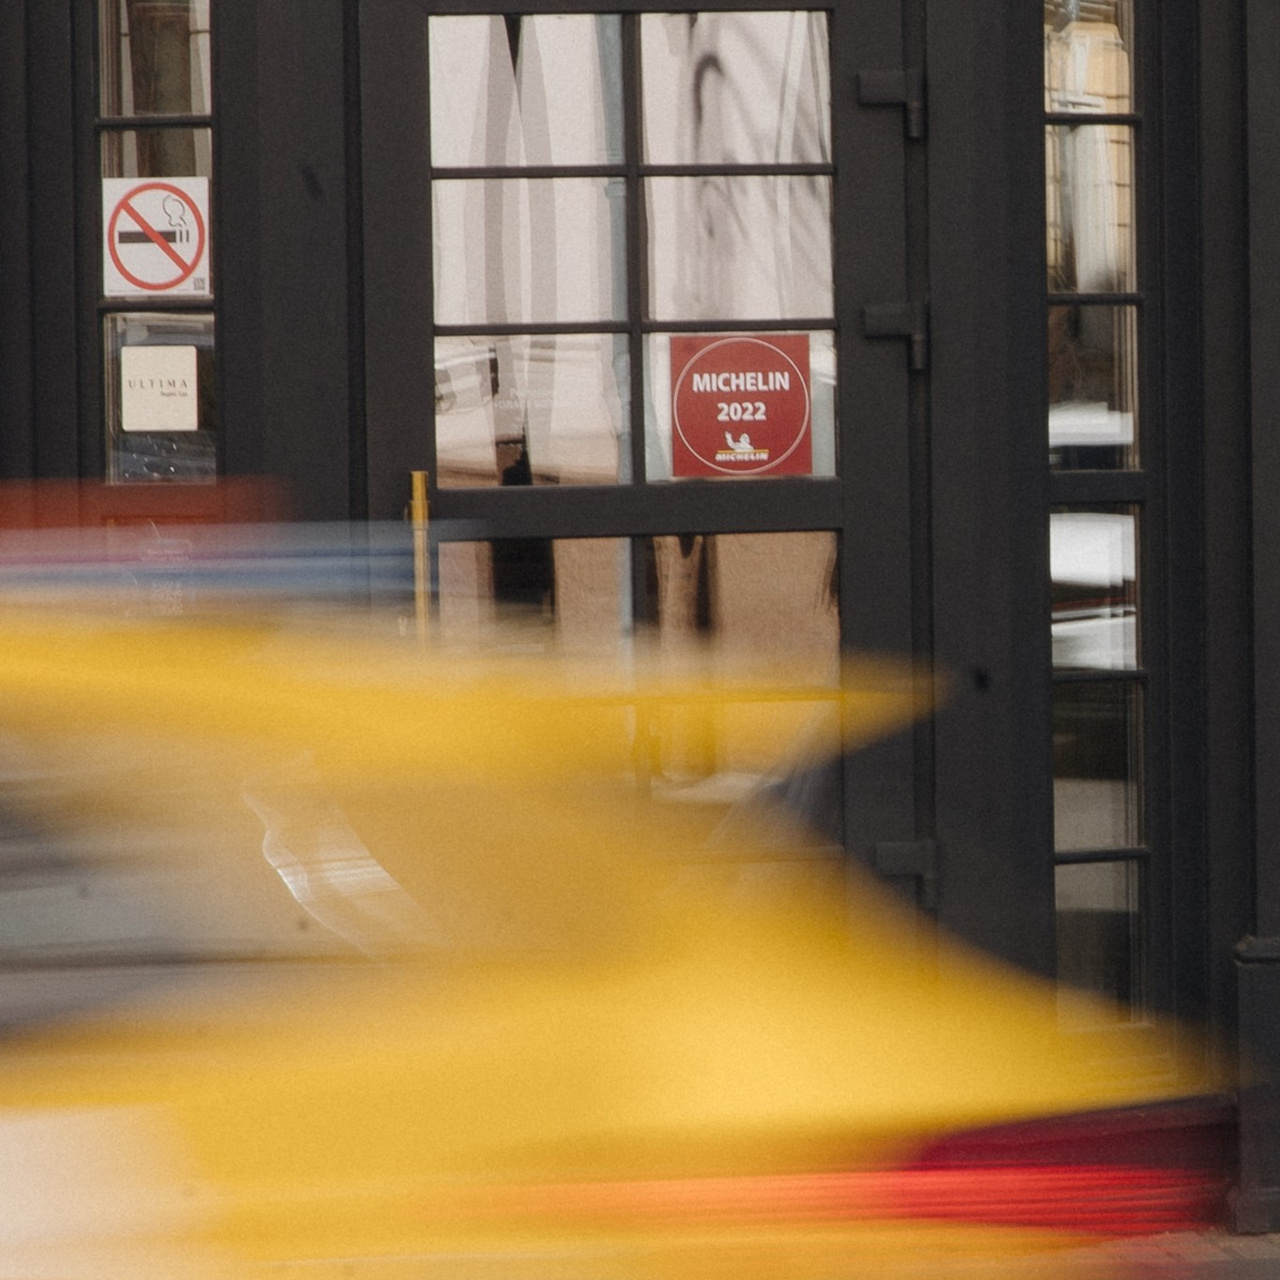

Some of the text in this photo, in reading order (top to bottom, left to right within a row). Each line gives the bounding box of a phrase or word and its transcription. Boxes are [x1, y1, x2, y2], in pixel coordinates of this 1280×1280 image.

[692, 371, 790, 393] MICHELIN
[716, 401, 767, 422] 2022
[715, 452, 769, 461] MICHELIN
